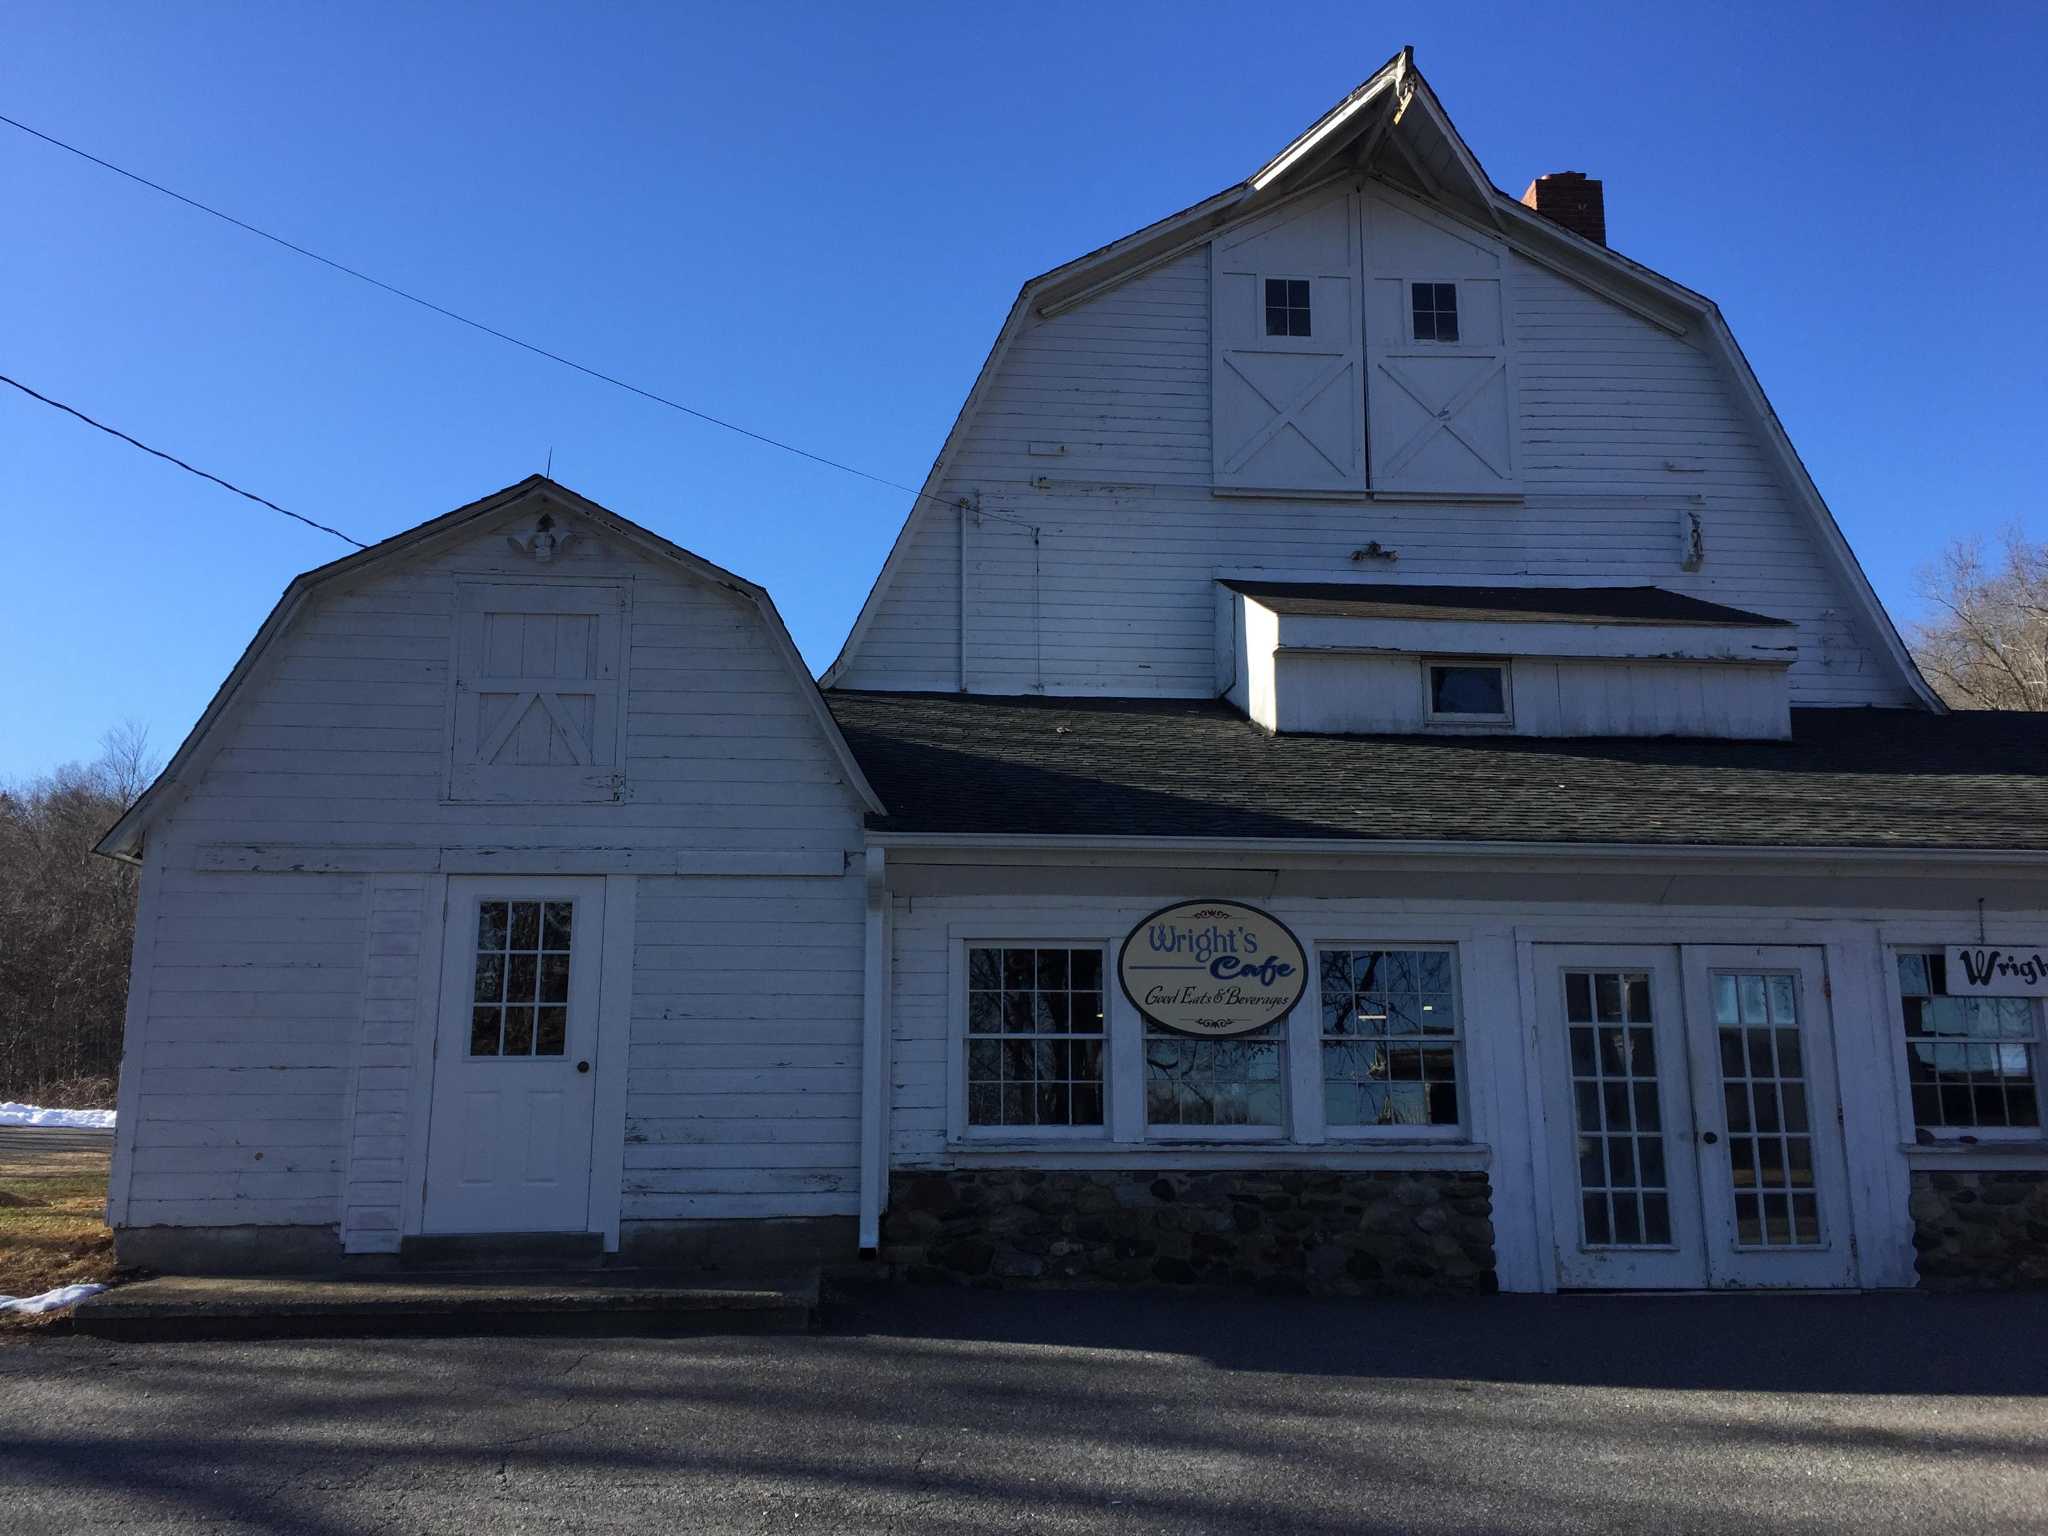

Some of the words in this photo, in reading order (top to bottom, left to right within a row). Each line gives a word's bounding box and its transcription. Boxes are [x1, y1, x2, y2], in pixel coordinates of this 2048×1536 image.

[1148, 923, 1258, 963] Wright's
[1209, 955, 1297, 986] Cafe
[1145, 985, 1179, 1005] Good
[1181, 986, 1212, 1005] Eats
[1214, 989, 1225, 1003] &
[1224, 986, 1289, 1011] Beverages
